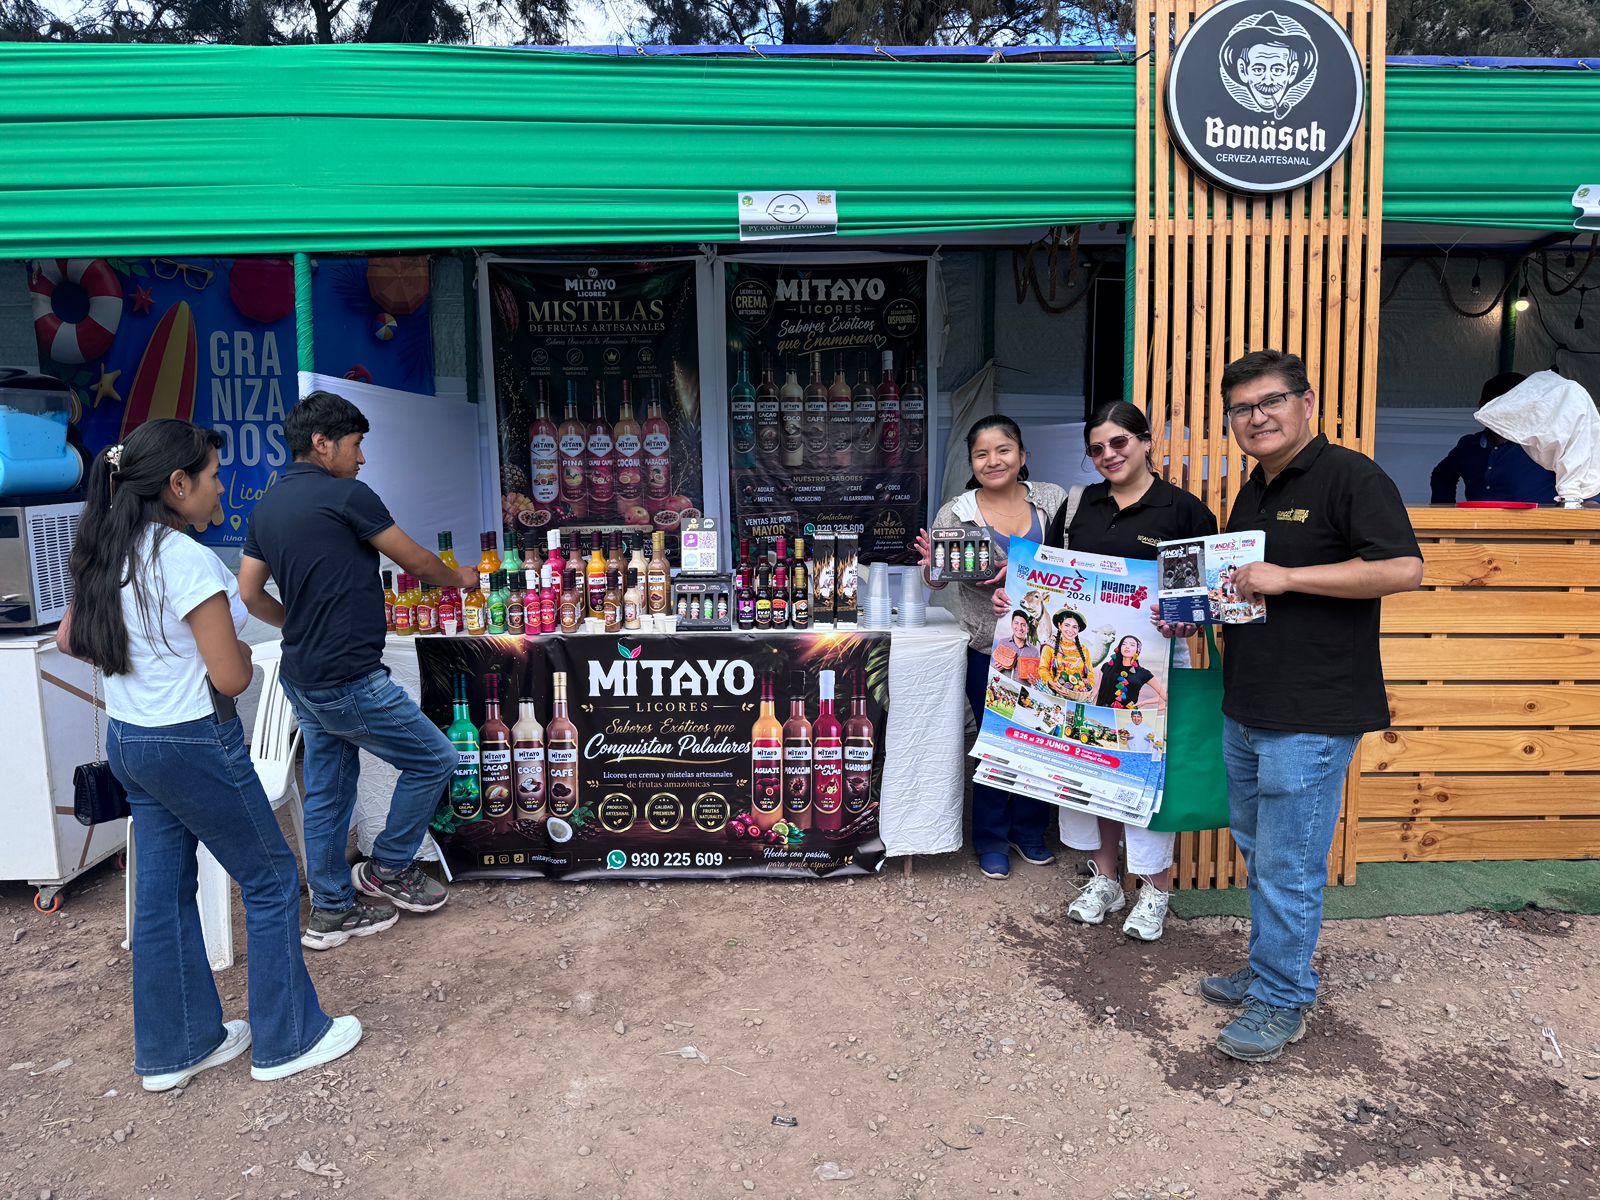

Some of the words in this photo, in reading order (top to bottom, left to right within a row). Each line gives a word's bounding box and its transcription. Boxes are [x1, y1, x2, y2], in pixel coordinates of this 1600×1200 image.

[1205, 117, 1326, 152] Bonäsch
[1216, 153, 1257, 163] CERVEZA
[1259, 155, 1311, 166] ARTESANAL
[565, 278, 617, 291] MITAYO
[776, 278, 885, 301] MITAYO
[735, 295, 768, 309] CREMA
[799, 304, 861, 314] LICORES
[527, 299, 664, 322] MISTELAS
[529, 324, 543, 332] DE
[547, 324, 588, 332] FRUTAS
[592, 322, 665, 332] ARTESANALES
[777, 319, 826, 338] Sabores
[829, 315, 876, 332] Exóticos
[777, 338, 801, 357] que
[802, 331, 874, 351] Enamoran
[210, 330, 282, 376] GRA
[211, 378, 286, 421] NIZA
[213, 423, 287, 467] DOS
[831, 474, 864, 482] SABORES
[744, 517, 769, 527] VENTAS
[770, 517, 778, 525] AL
[778, 516, 792, 524] POR
[752, 524, 786, 537] MAYOR
[873, 527, 906, 536] MITAYO
[756, 537, 761, 545] Y
[1215, 542, 1236, 550] ANDES
[1026, 569, 1085, 592] ANDES
[1066, 590, 1092, 602] 2026
[588, 659, 756, 697] MITAYO
[636, 702, 709, 713] LICORES
[605, 718, 653, 734] Sabores
[659, 717, 710, 735] Exóticos
[714, 722, 735, 742] que
[584, 733, 674, 763] Conquistan
[678, 734, 752, 757] Paladares
[1035, 737, 1045, 745] 29
[1045, 739, 1070, 752] JUNIO
[517, 766, 543, 775] COCO
[603, 771, 628, 779] Licores
[666, 771, 695, 779] mistelas
[695, 771, 733, 779] artesanales
[639, 780, 662, 788] frutas
[663, 780, 710, 788] amazónicas
[631, 853, 660, 867] 930
[663, 852, 691, 866] 225
[695, 852, 723, 866] 609
[763, 847, 789, 859] Hecho
[801, 850, 832, 864] pasión,
[765, 861, 785, 872] para
[787, 861, 809, 872] gente
[810, 858, 840, 872] especial
